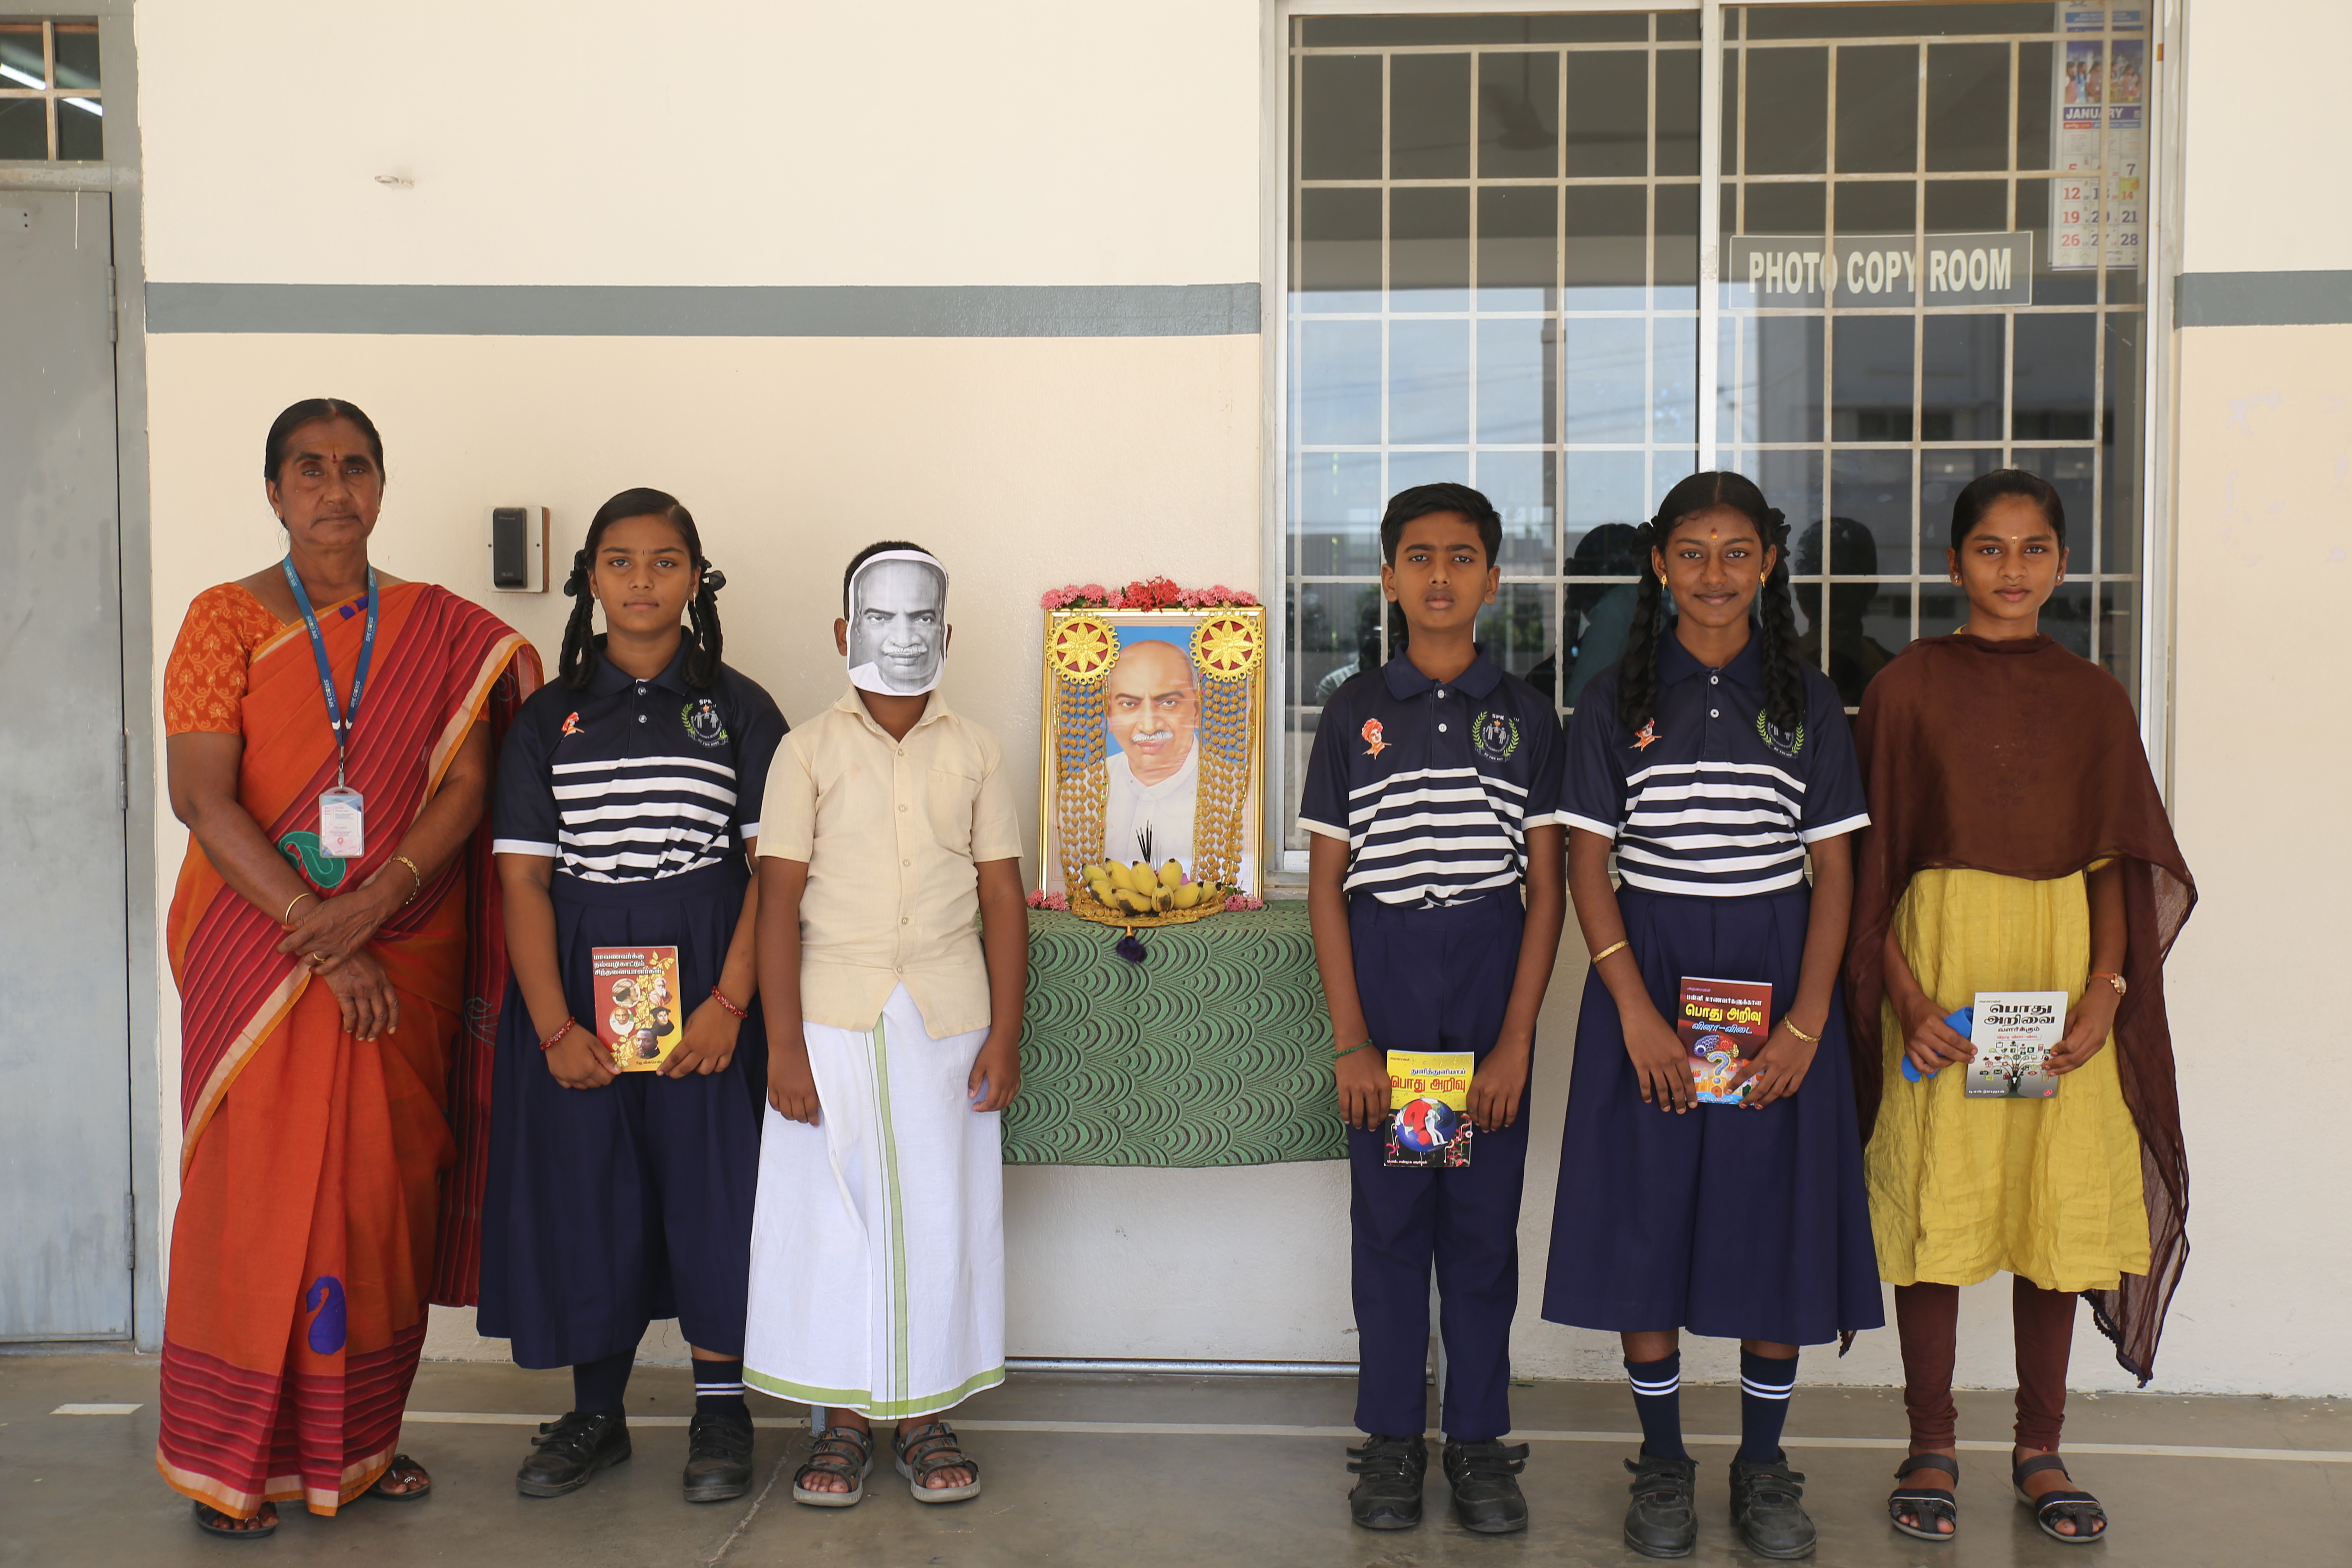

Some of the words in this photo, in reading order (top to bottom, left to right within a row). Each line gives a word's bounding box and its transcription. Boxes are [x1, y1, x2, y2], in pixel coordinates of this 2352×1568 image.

[2066, 108, 2123, 119] JANURY
[2126, 163, 2136, 176] 7
[2063, 187, 2081, 200] 12
[2122, 191, 2134, 200] 14
[2062, 211, 2080, 224] 19
[2122, 211, 2138, 223] 21
[2061, 234, 2080, 247] 26
[2120, 233, 2138, 246] 28
[1749, 251, 1838, 294] PHOTO
[1847, 251, 1917, 294] COPY
[1930, 248, 2012, 292] ROOM
[1687, 994, 1704, 1002] பள்ளி
[1705, 995, 1762, 1006] மாணவர்களுக்கான
[1685, 1003, 1723, 1022] பொது
[1727, 1006, 1761, 1026] அறிவு
[1990, 1004, 2052, 1016] பொது
[1984, 1014, 2055, 1028] அறிவை
[1411, 1067, 1466, 1076] துளித்துளியாய்
[1390, 1075, 1426, 1093] பொது
[1430, 1077, 1466, 1093] அறிவு
